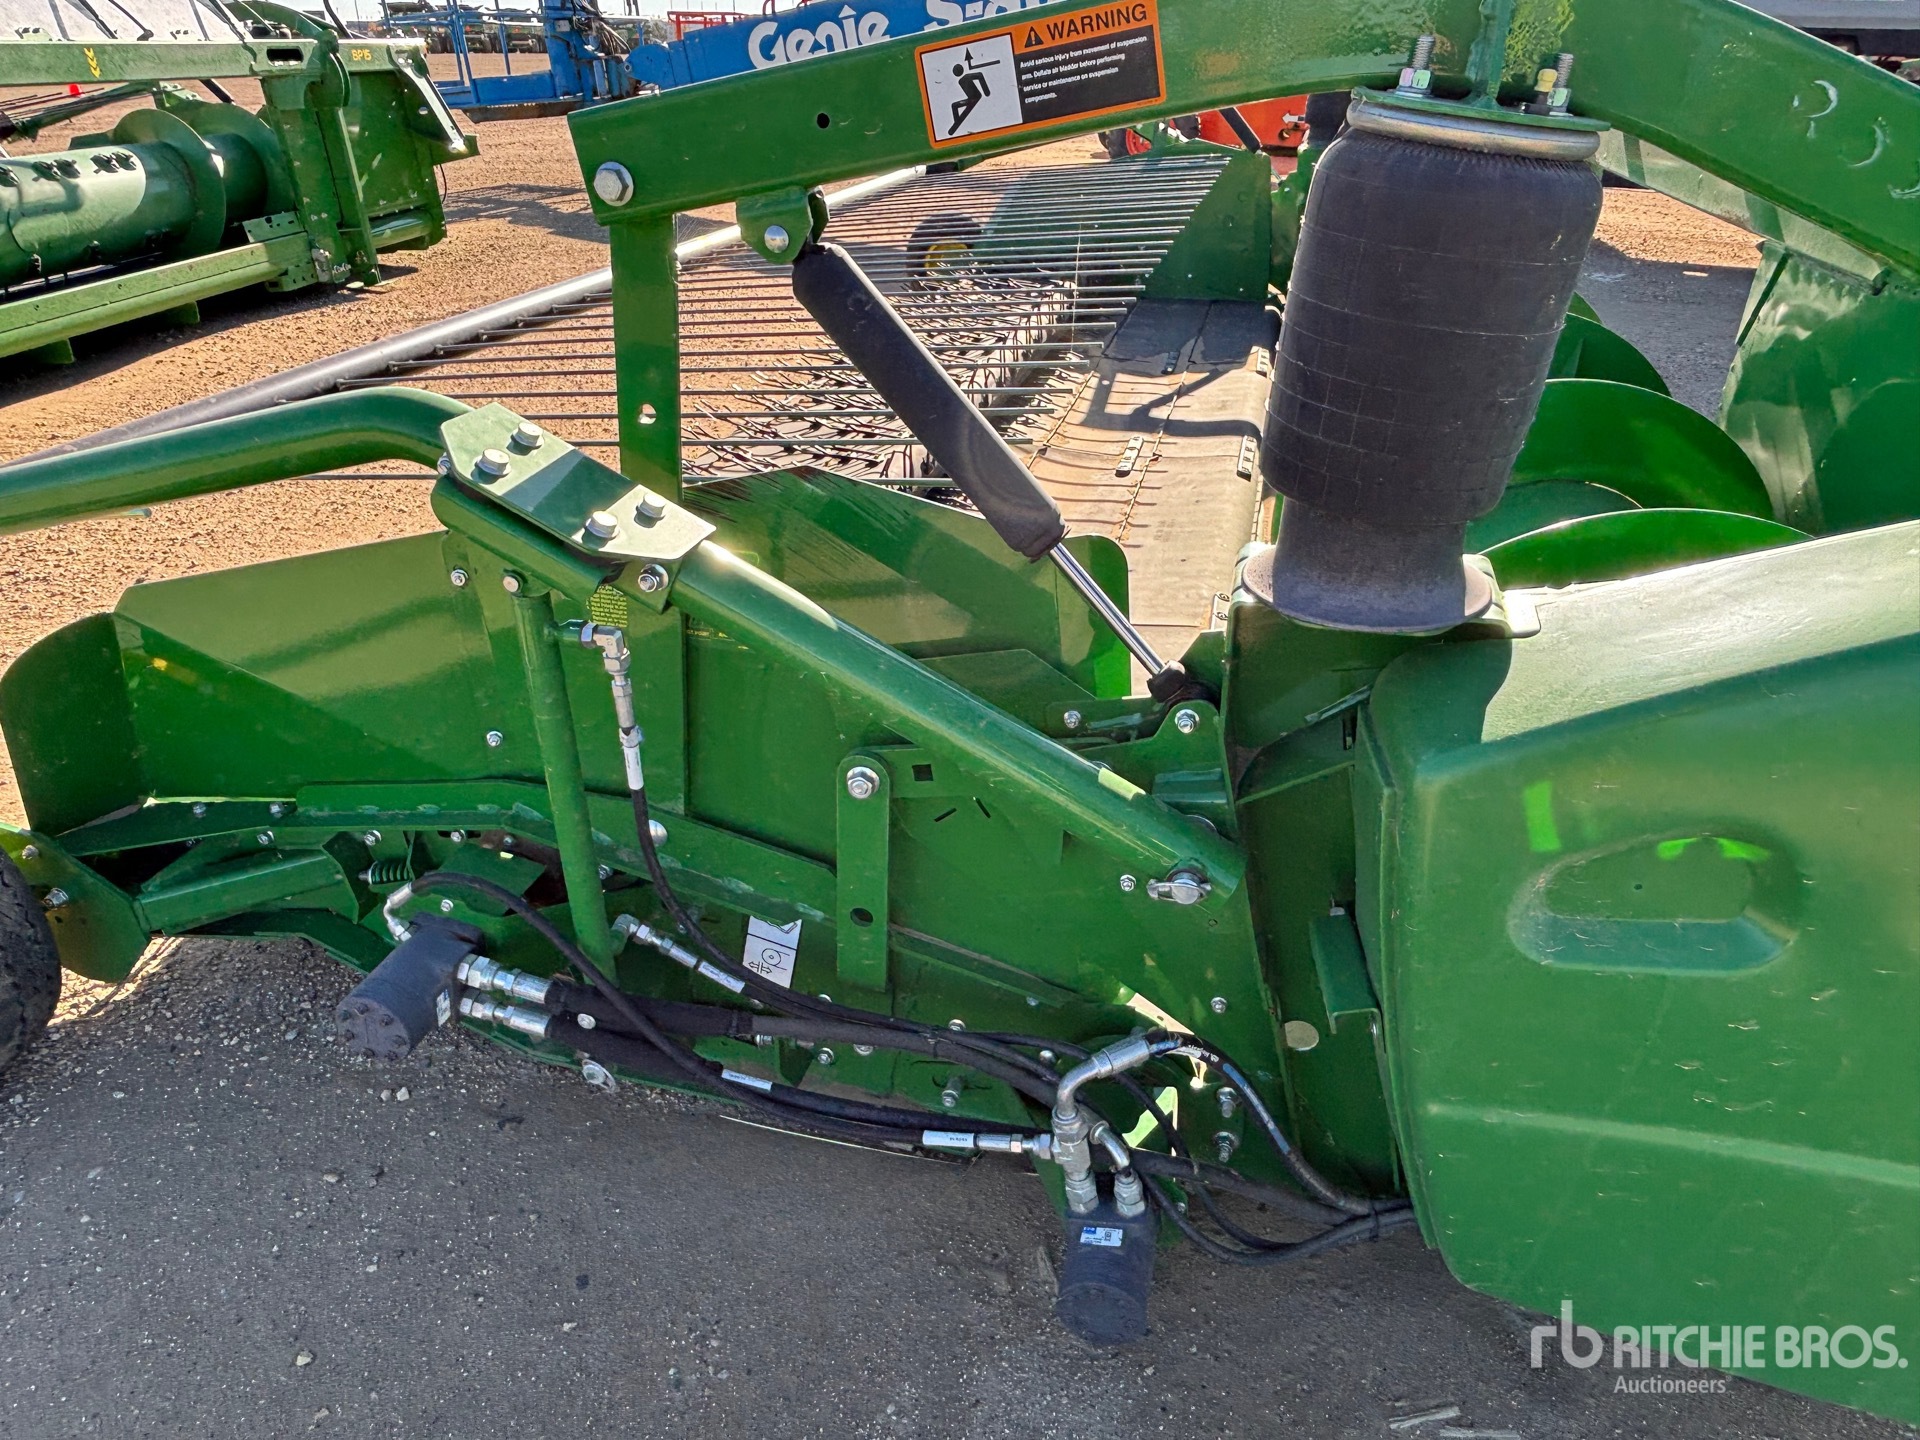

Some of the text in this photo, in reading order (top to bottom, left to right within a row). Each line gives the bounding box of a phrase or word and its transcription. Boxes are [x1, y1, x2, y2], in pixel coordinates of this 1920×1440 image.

[748, 5, 890, 69] Genie
[1046, 3, 1147, 41] WARNING
[1020, 35, 1148, 69] Avoid serious injury from movement of suspension
[1033, 68, 1052, 78] Deflate
[1059, 62, 1079, 73] bladder
[1079, 58, 1096, 68] before
[1096, 52, 1126, 66] performing
[1023, 82, 1042, 92] service
[1042, 81, 1048, 89] or
[1048, 74, 1080, 87] maintenance
[1088, 66, 1119, 79] suspension
[1024, 91, 1058, 104] components.
